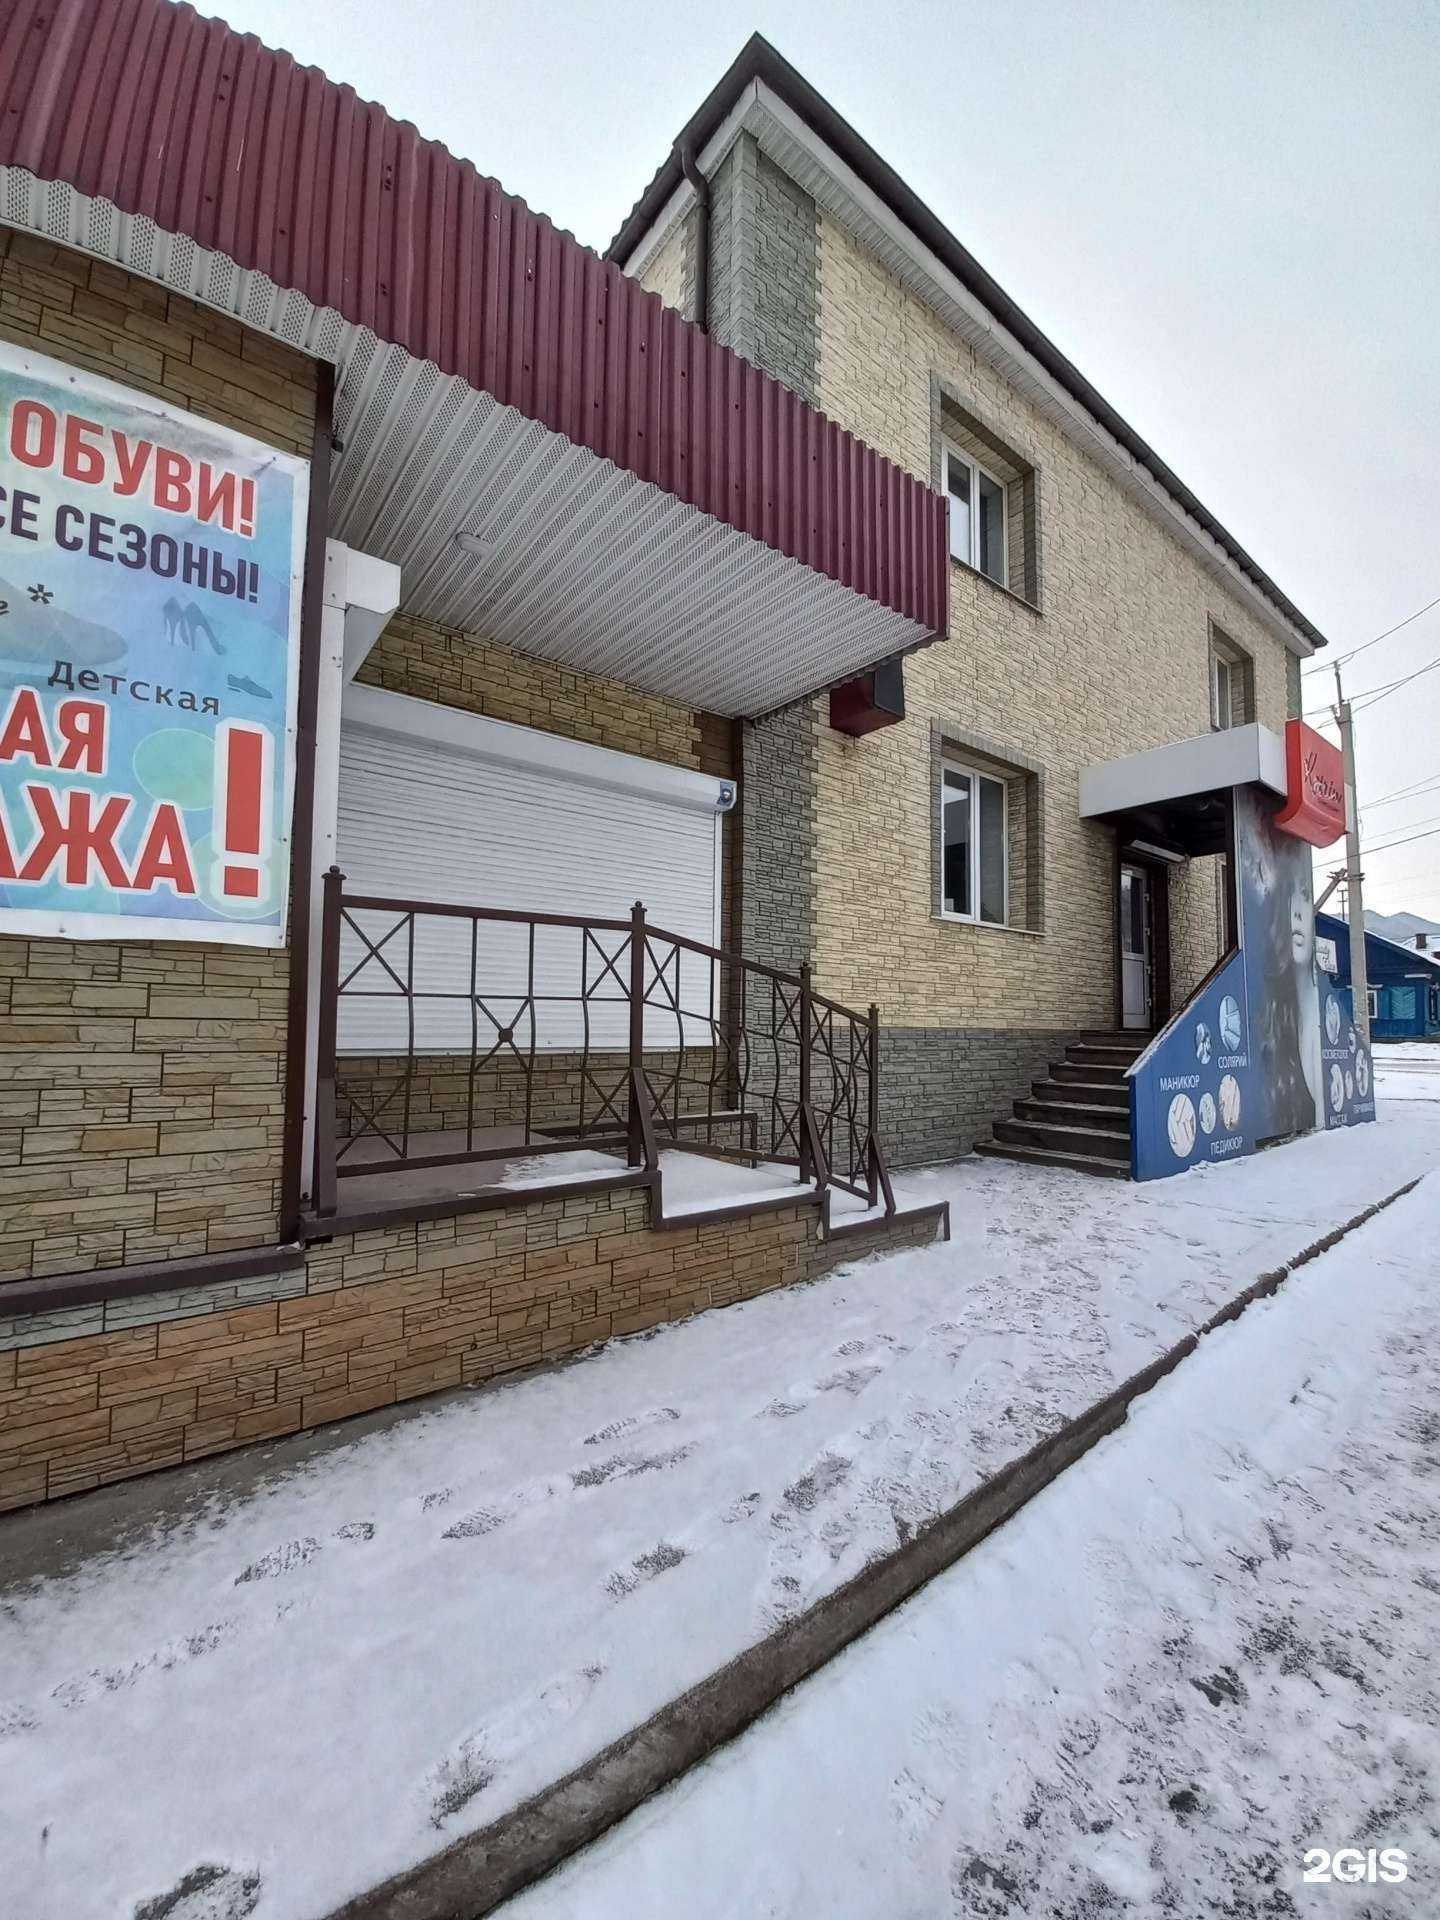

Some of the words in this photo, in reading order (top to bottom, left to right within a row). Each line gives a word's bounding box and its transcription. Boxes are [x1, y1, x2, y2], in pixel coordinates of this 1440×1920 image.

[10, 399, 255, 538] ОБУВИ!
[54, 504, 259, 604] СЕЗОНЫ!
[1160, 1074, 1200, 1092] МАНИКЮР
[1210, 1136, 1244, 1156] ПЕДИКЮР
